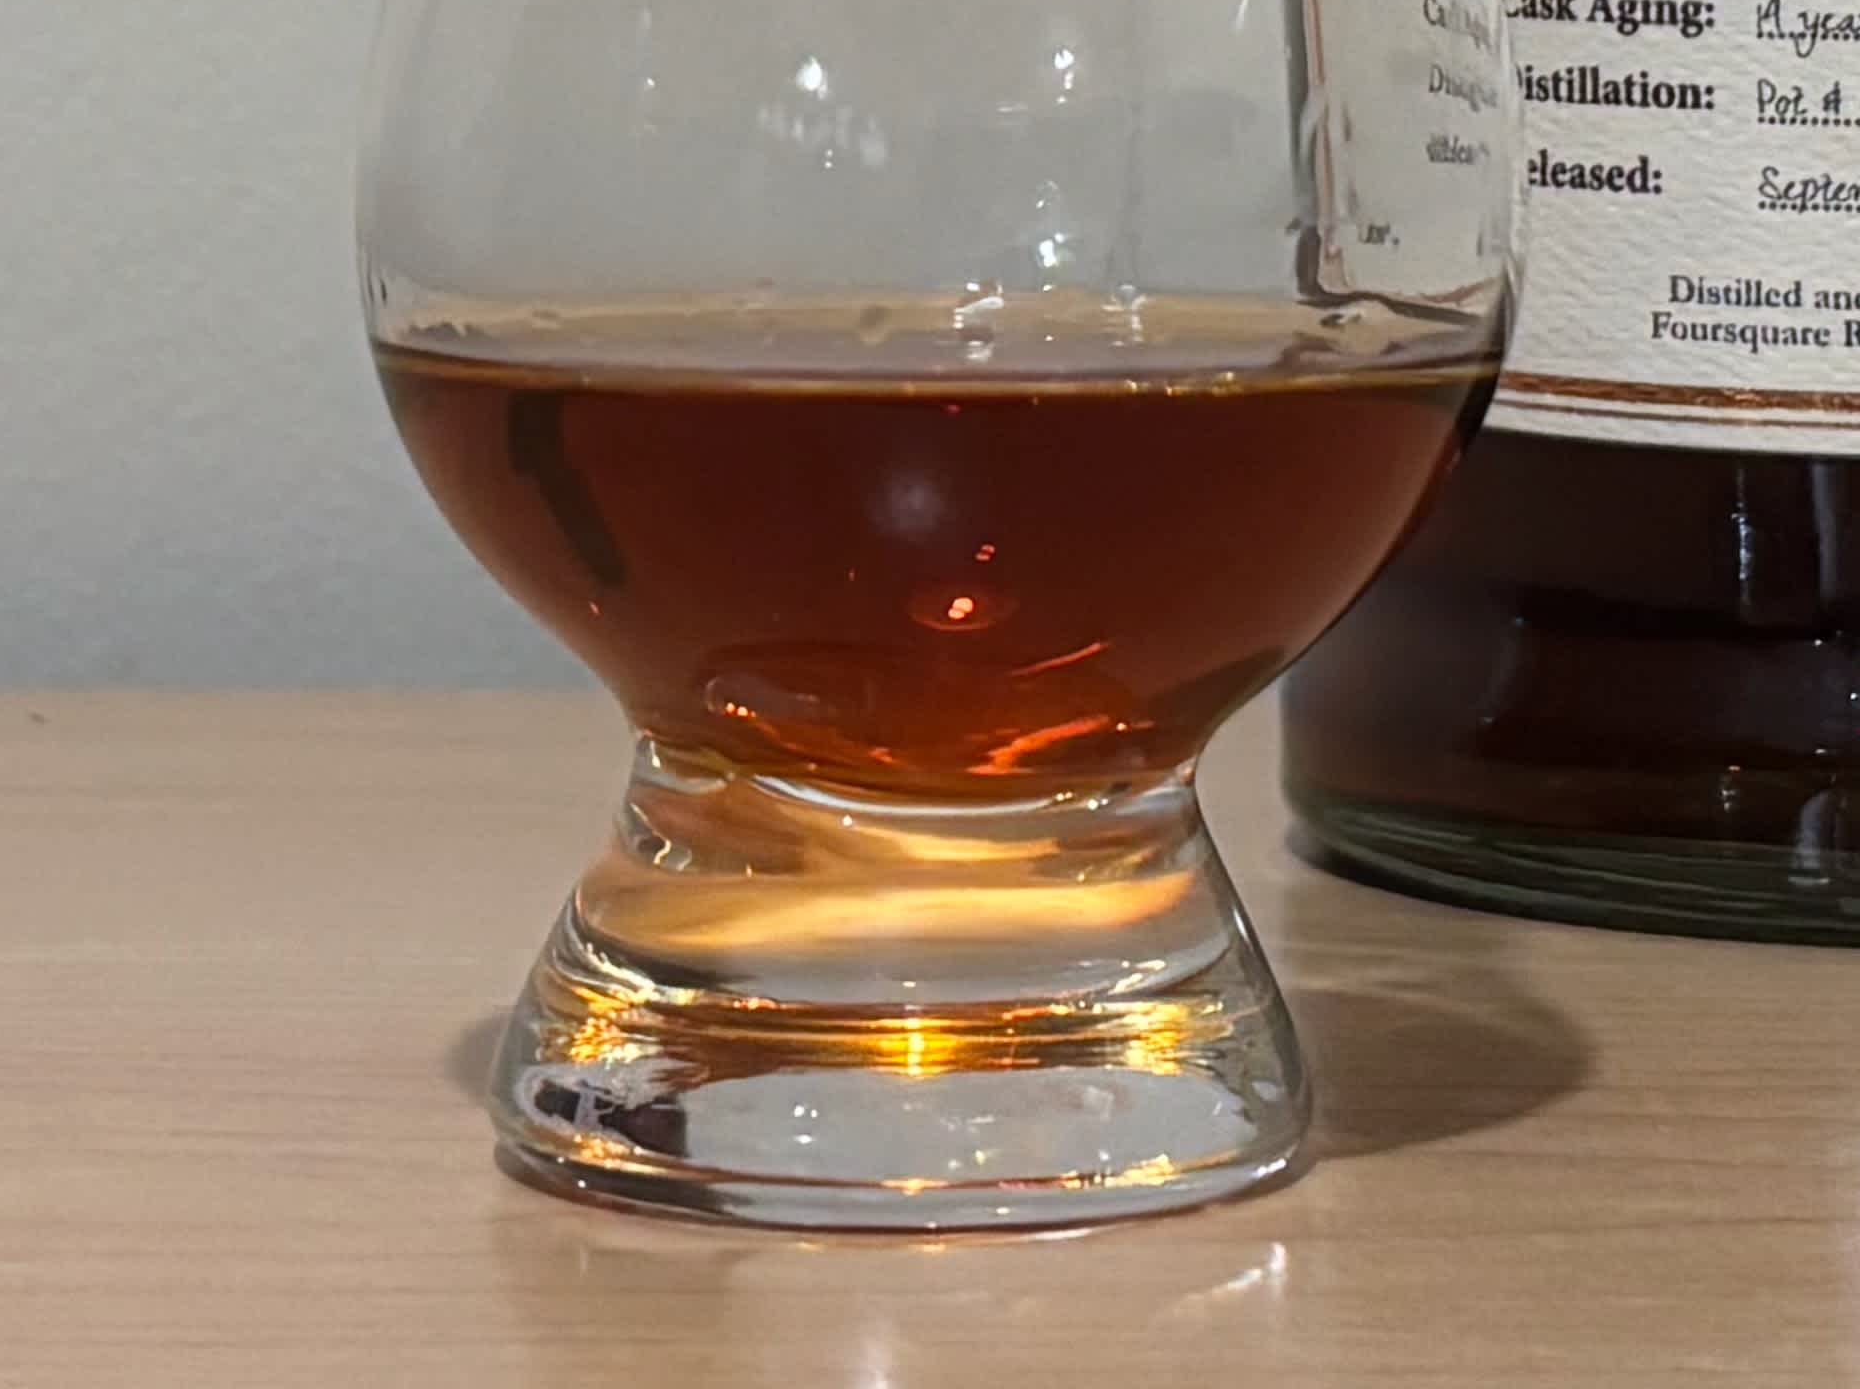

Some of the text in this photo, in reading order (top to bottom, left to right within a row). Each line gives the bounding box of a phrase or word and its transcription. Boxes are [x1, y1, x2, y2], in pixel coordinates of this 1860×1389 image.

[1516, 63, 1715, 110] istillation:
[1756, 78, 1808, 117] Pot
[1527, 148, 1663, 195] eleased:
[1668, 274, 1803, 309] Distilled
[1650, 311, 1832, 353] Foursquare
